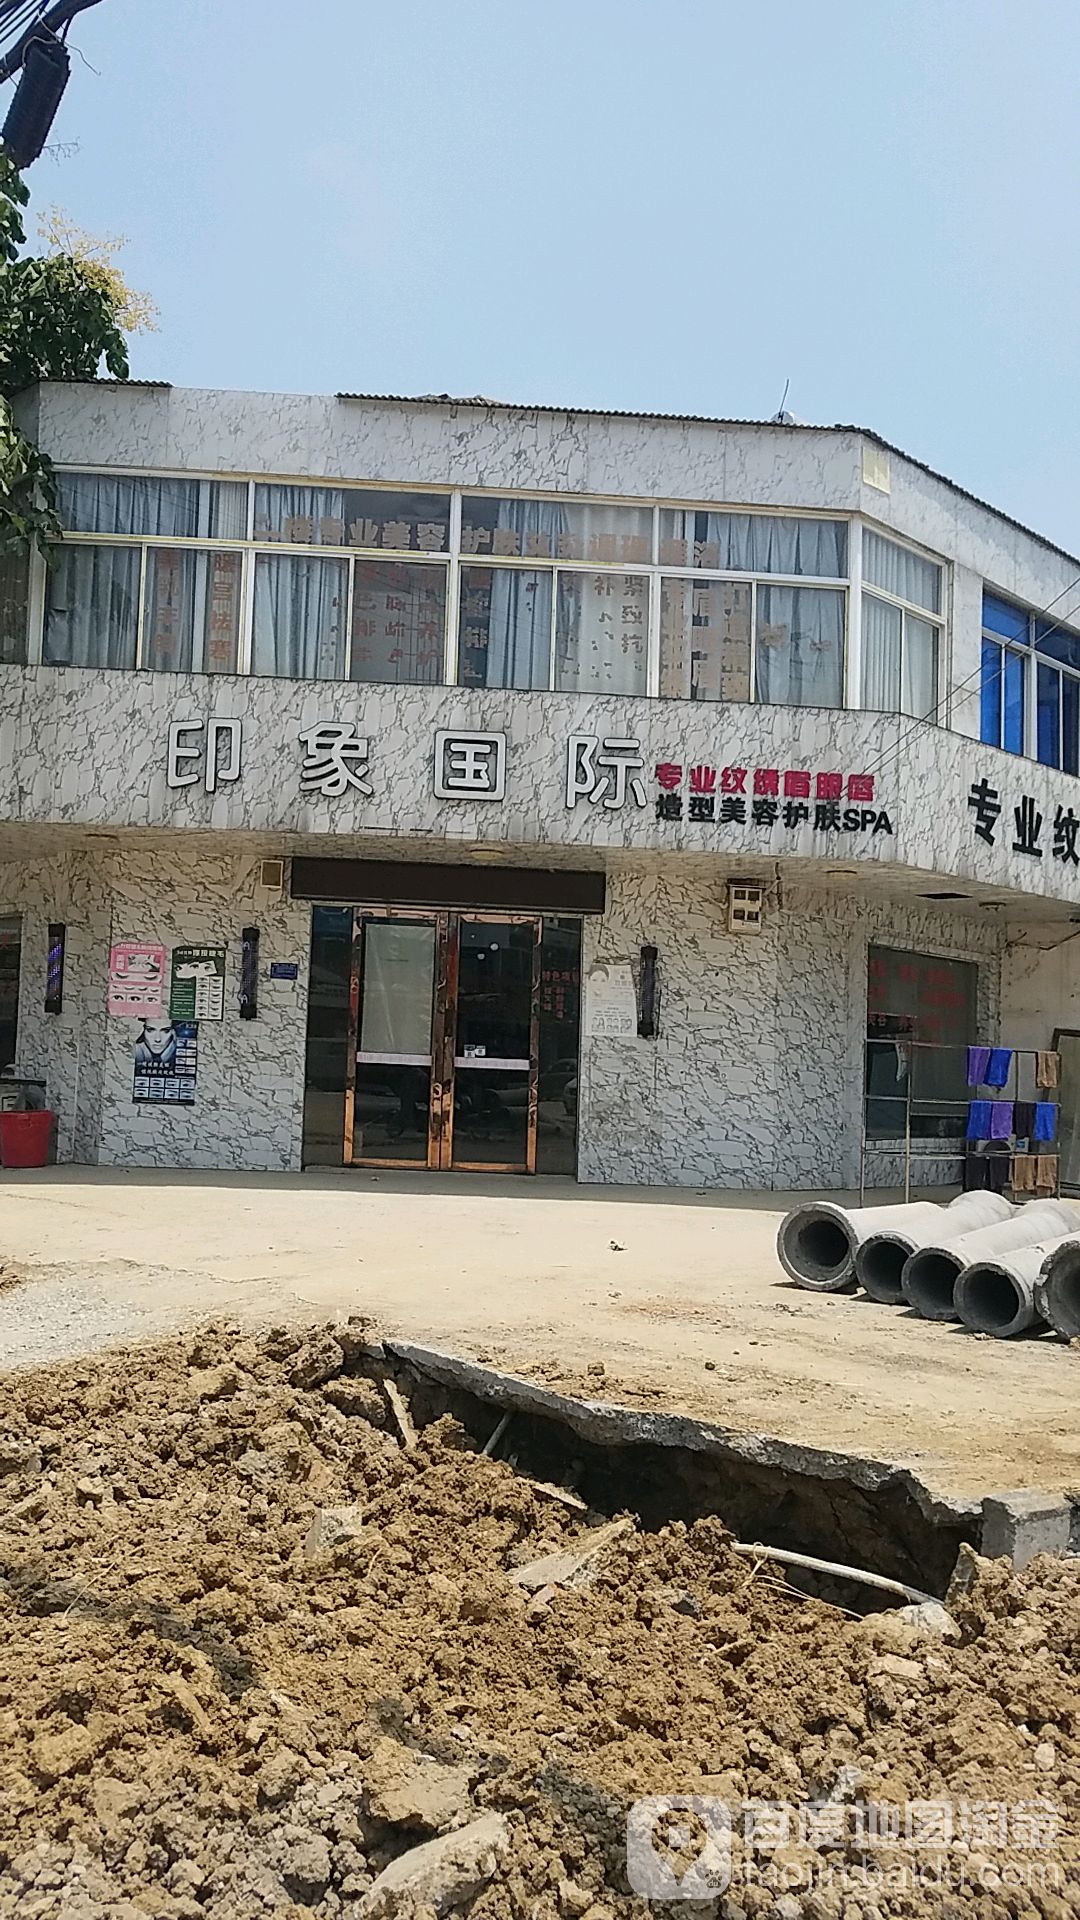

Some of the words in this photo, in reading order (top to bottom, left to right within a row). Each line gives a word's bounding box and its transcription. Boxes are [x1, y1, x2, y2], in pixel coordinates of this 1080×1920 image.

[167, 716, 648, 810] 印象国际
[655, 762, 875, 802] 专业纹绣眉眼唇
[655, 792, 894, 835] 造型美容护肤SPA
[967, 777, 1080, 867] 专业纹
